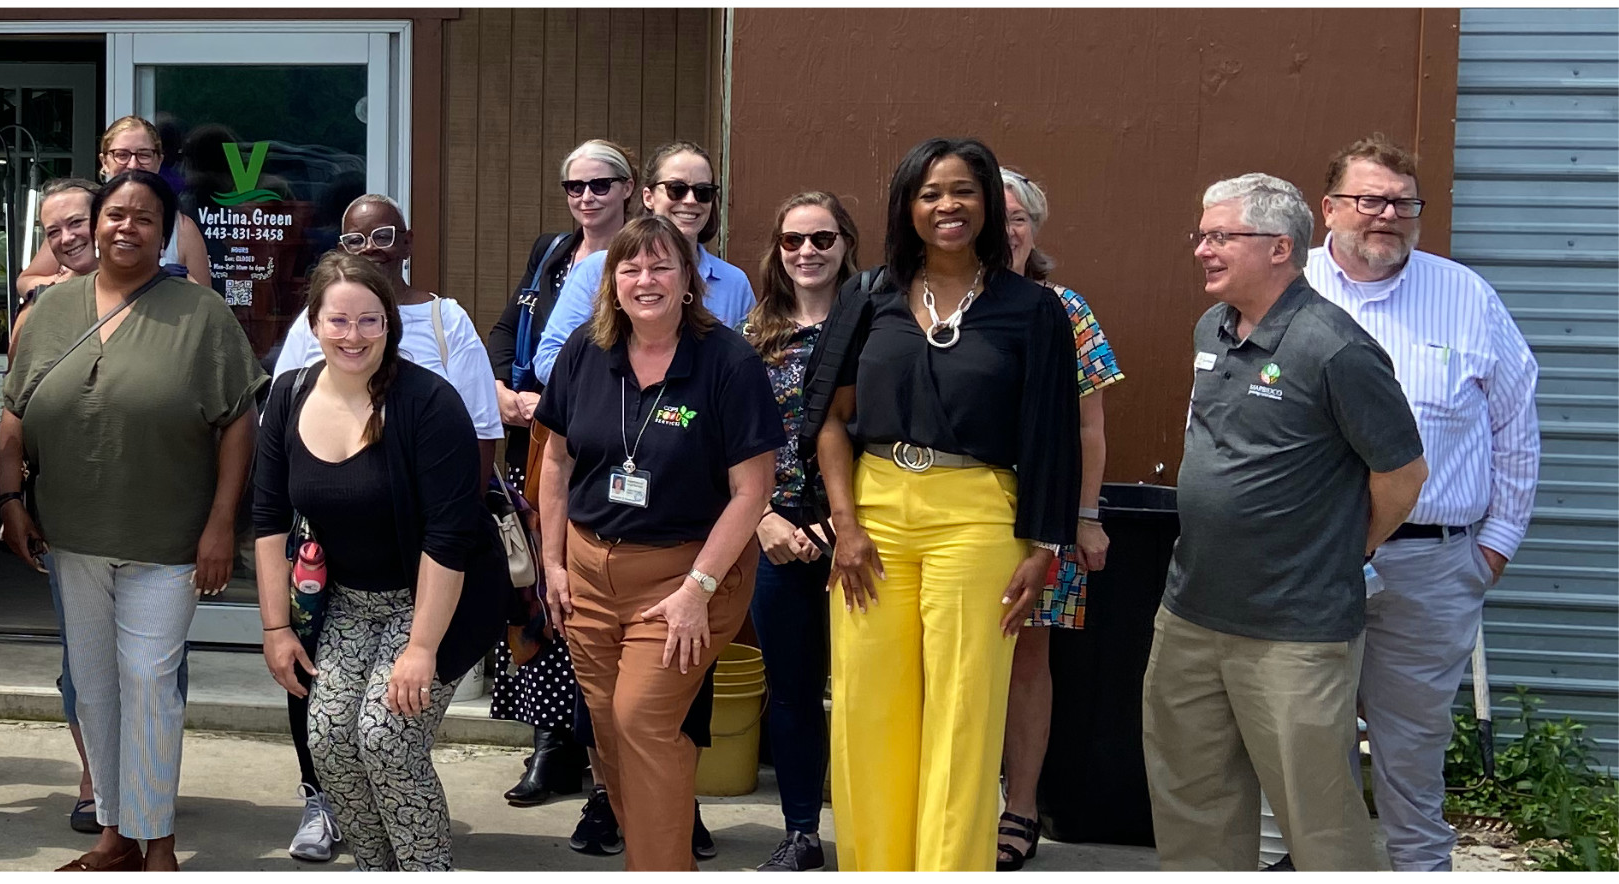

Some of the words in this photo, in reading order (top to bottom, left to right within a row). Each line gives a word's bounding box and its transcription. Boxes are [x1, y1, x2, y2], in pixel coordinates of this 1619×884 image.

[222, 143, 270, 194] V
[198, 206, 293, 226] VerLina.Green
[204, 226, 284, 241] 443-831-3458
